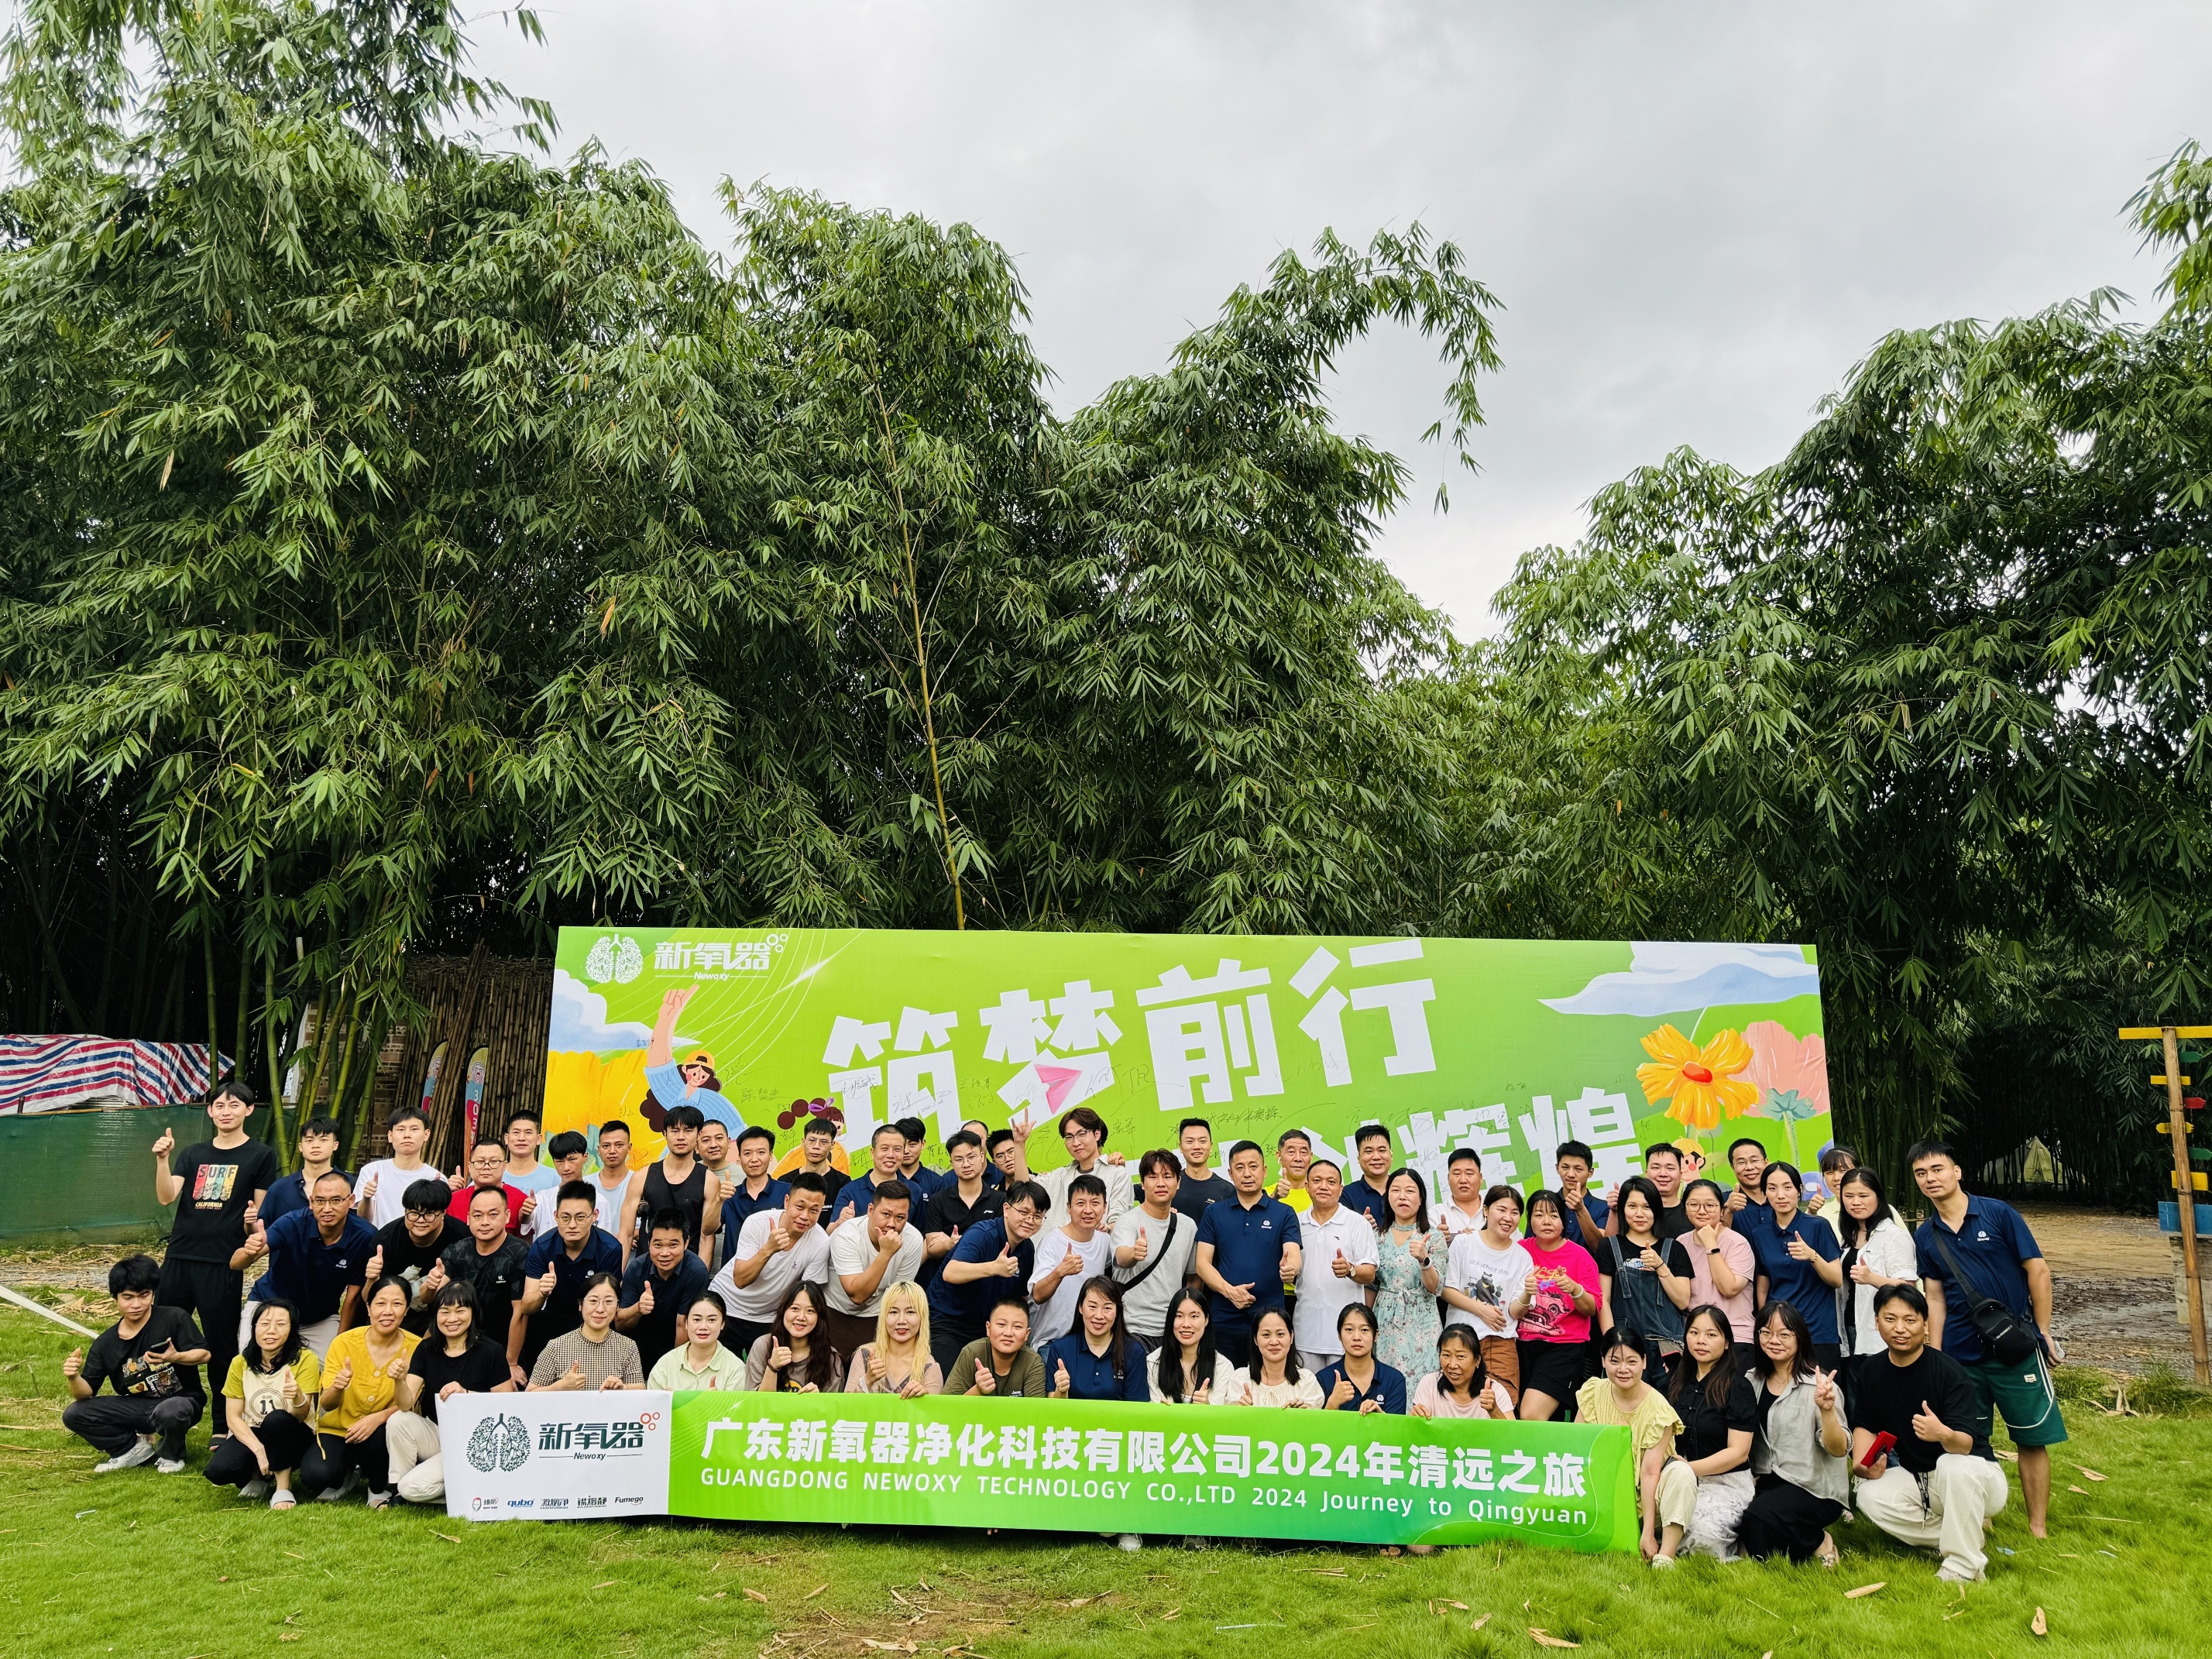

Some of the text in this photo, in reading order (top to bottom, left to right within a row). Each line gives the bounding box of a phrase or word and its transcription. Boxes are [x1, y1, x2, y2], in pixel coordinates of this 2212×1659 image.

[654, 941, 770, 970] 新氧器
[693, 971, 730, 982] Newoxy
[823, 939, 1437, 1155] 筑梦前行
[198, 1166, 235, 1178] SURF
[538, 1422, 644, 1450] 新氧器
[574, 1451, 606, 1462] Newoxy
[702, 1417, 1588, 1498] 广东新氧器净化科技有限公司2024年清远之旅
[507, 1499, 534, 1507] qubo
[615, 1496, 644, 1505] Fumego
[701, 1468, 1586, 1526] GUANGDONG NEWOXY TECHNOLOGY CO.,LTD 2024 Journey to Qingyuan
